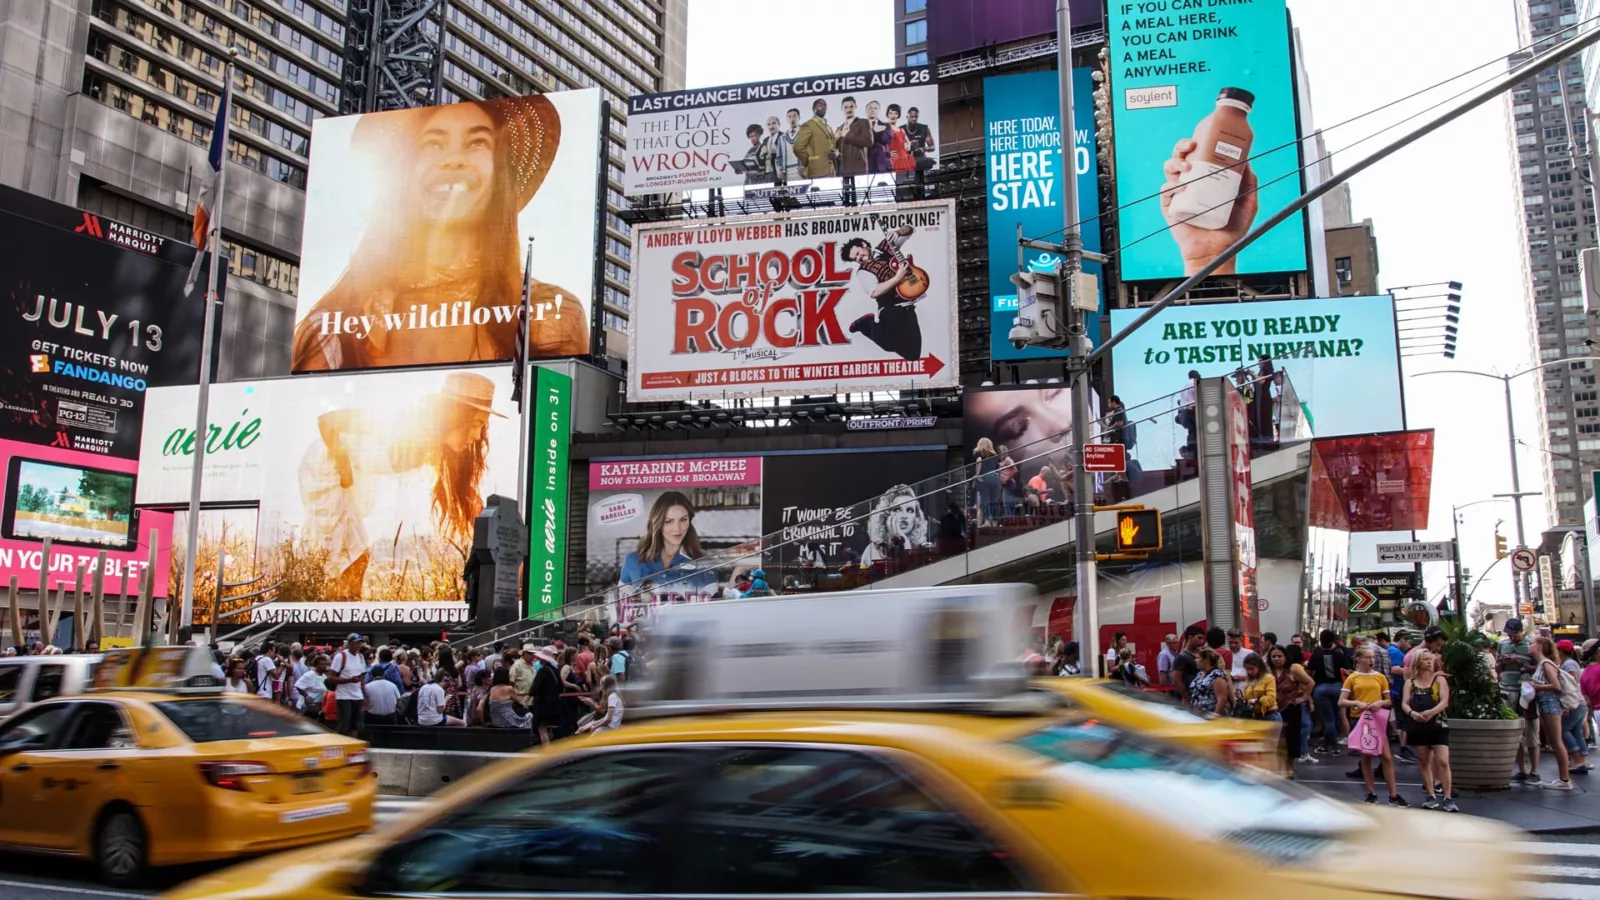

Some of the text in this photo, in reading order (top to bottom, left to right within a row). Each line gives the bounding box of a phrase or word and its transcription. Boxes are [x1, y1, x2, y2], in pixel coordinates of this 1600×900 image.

[1121, 4, 1133, 15] IF
[1137, 1, 1167, 13] YOU
[1172, 0, 1203, 10] CAN
[1122, 12, 1222, 31] A MEAL HERE,
[1122, 26, 1238, 47] YOU CAN DRINK
[1124, 49, 1176, 63] A MEAL
[1124, 61, 1211, 79] ANYWHERE.
[633, 70, 930, 112] LAST CHANCE! MUST CLOTHES AUG 26
[1130, 90, 1173, 104] soylent
[641, 111, 722, 133] THE PLAY
[990, 116, 1057, 136] HERE TODAY.
[633, 128, 730, 150] THAT GOES
[991, 129, 1091, 152] HERE TOMORW.
[632, 150, 730, 173] WRONG
[991, 150, 1054, 182] HERE
[646, 171, 710, 182] BROADWAY'S FUNNIEST
[646, 177, 708, 188] LONGEST-RUNNING
[992, 179, 1056, 211] STAY.
[110, 222, 164, 246] MARRIOTT
[697, 228, 732, 244] LLOYD
[736, 224, 782, 241] WEBBER
[785, 222, 808, 237] HAS
[812, 216, 878, 236] BROADWAY
[108, 232, 158, 254] MARQUIS
[671, 241, 853, 297] SCHOOL
[742, 280, 779, 315] of
[22, 295, 163, 352] JULY 13
[320, 310, 376, 340] Hey
[670, 288, 852, 355] ROCK
[1162, 315, 1341, 340] ARE YOU READY
[32, 339, 149, 375] GET TICKETS NOW
[745, 350, 777, 360] MUSICAL
[1144, 338, 1364, 365] to TASTE NIRVANA?
[54, 360, 147, 392] FANDANGO
[695, 360, 925, 384] JUST 4 BLOCKS TO THE WINTER GARDEN THEATRE
[49, 386, 71, 397] THEATERS
[71, 389, 81, 398] AND
[120, 400, 134, 408] 3D
[5, 404, 39, 415] LEGENDARY
[59, 409, 86, 422] PG-13
[163, 408, 262, 457] aerie
[550, 411, 558, 432] on
[850, 418, 934, 429] OUTFRONT PRIME
[74, 442, 109, 454] MARQUIS
[75, 436, 114, 447] MARRIOTT
[546, 439, 557, 491] inside
[601, 462, 685, 476] KATHARINE
[601, 473, 746, 486] NOW STARRING ON BROADWAY
[601, 508, 636, 521] BAREILLES
[609, 504, 626, 512] SARA
[782, 506, 797, 523] IT
[836, 507, 855, 520] BE
[541, 498, 556, 554] aerie
[841, 523, 855, 537] TO
[829, 543, 842, 556] IT
[1380, 545, 1412, 553] PEDESTRIAN
[1421, 552, 1443, 560] MOVING
[17, 550, 74, 573] YOUR
[542, 559, 555, 604] Shop
[1541, 556, 1556, 622] BARRYMORE
[253, 607, 344, 624] AMERICAN
[351, 607, 405, 624] EAGLE
